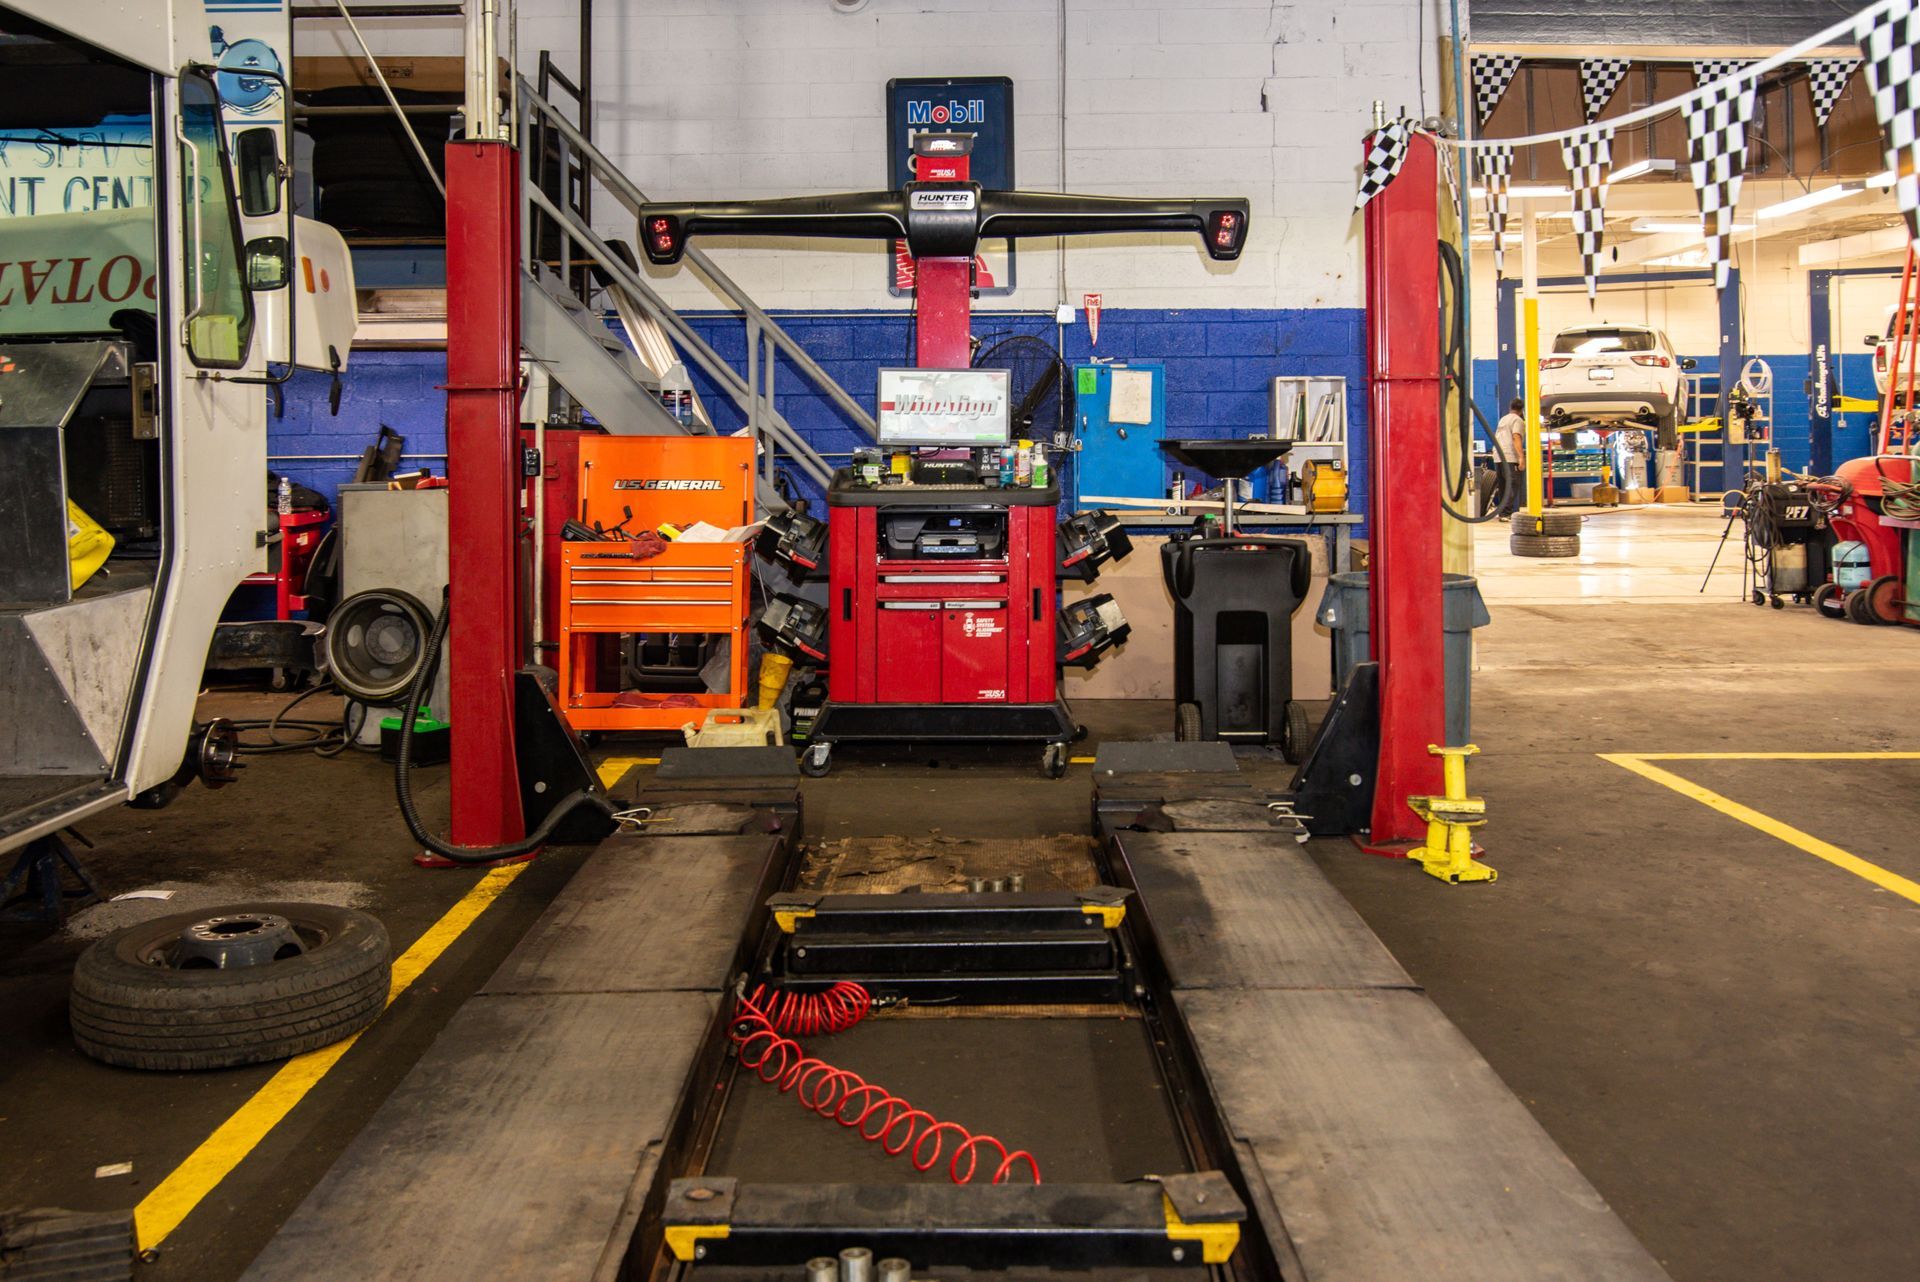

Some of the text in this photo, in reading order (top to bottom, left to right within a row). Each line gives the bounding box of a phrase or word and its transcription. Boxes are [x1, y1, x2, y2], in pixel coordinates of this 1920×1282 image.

[907, 100, 984, 123] Mobil
[1816, 344, 1826, 361] Lifts
[1814, 361, 1829, 404] Challenger
[894, 395, 999, 421] WinAlign
